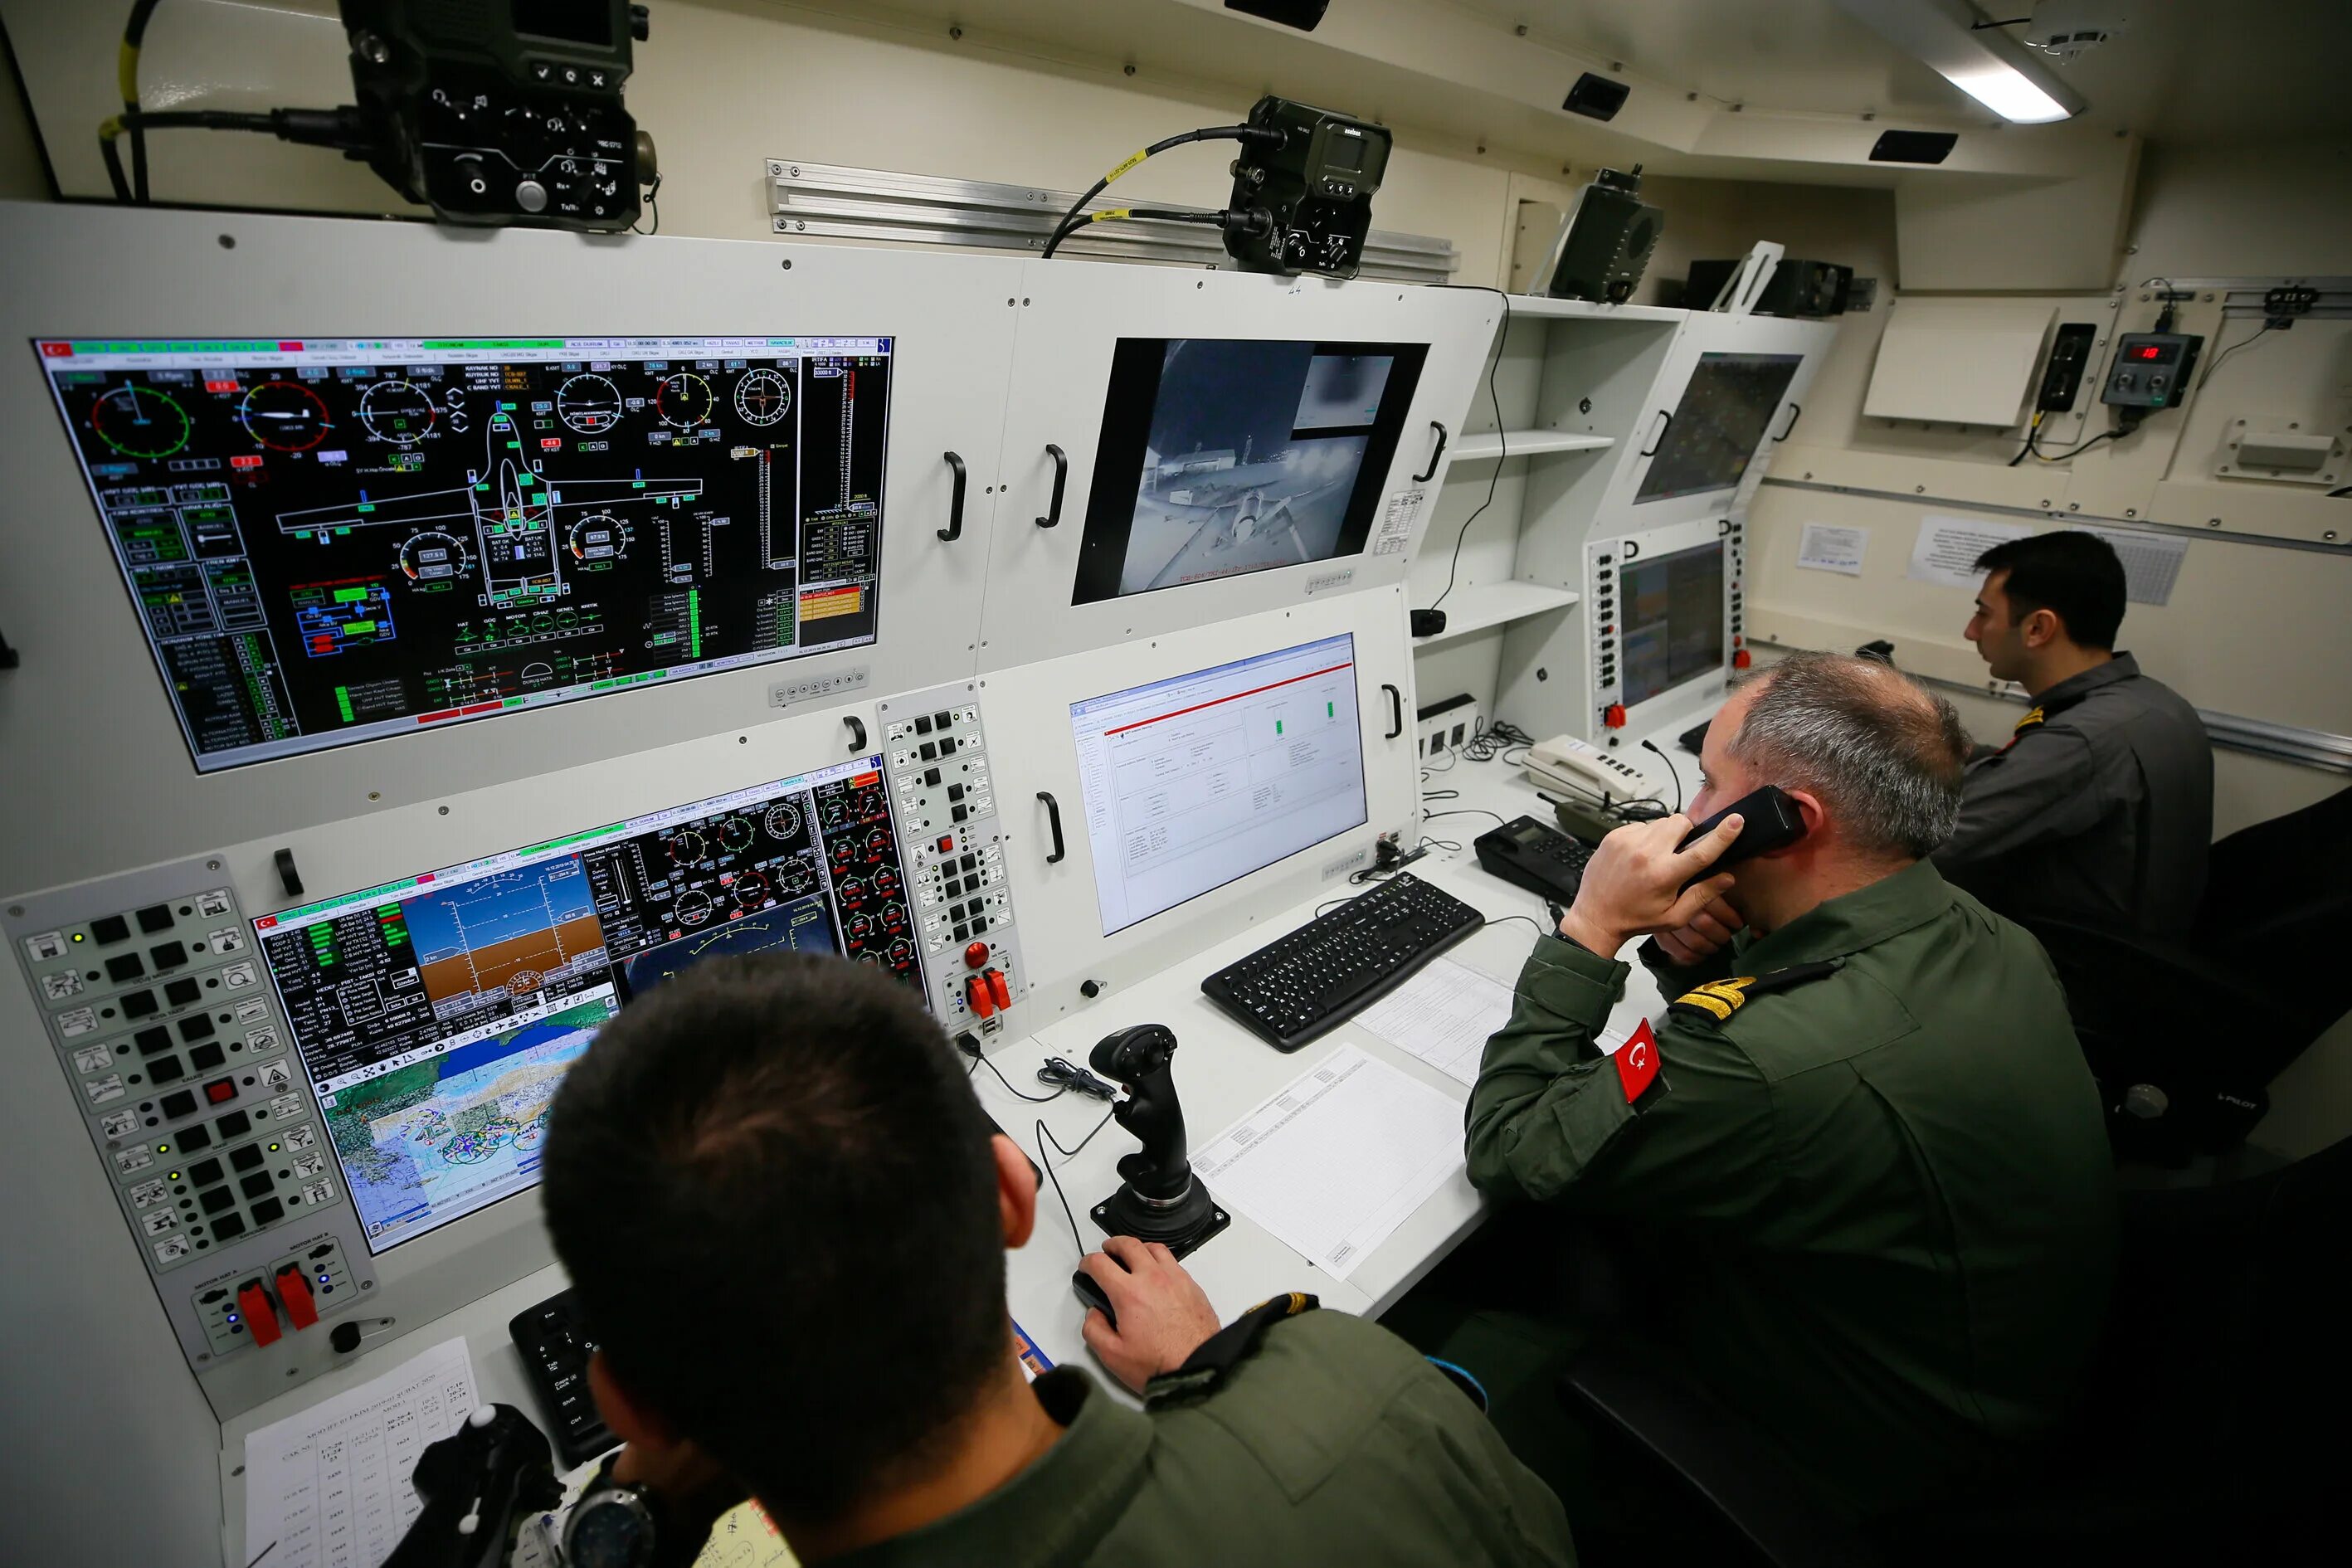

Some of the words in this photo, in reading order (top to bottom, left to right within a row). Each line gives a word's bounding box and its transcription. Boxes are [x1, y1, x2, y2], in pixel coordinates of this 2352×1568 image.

[290, 1239, 311, 1250] MOTOR
[194, 1277, 218, 1289] MOTOR
[219, 1272, 231, 1281] HAT
[554, 1377, 569, 1386] Caps
[556, 1382, 569, 1390] Lock
[562, 1396, 576, 1406] Shift
[570, 1416, 582, 1424] Ctrl
